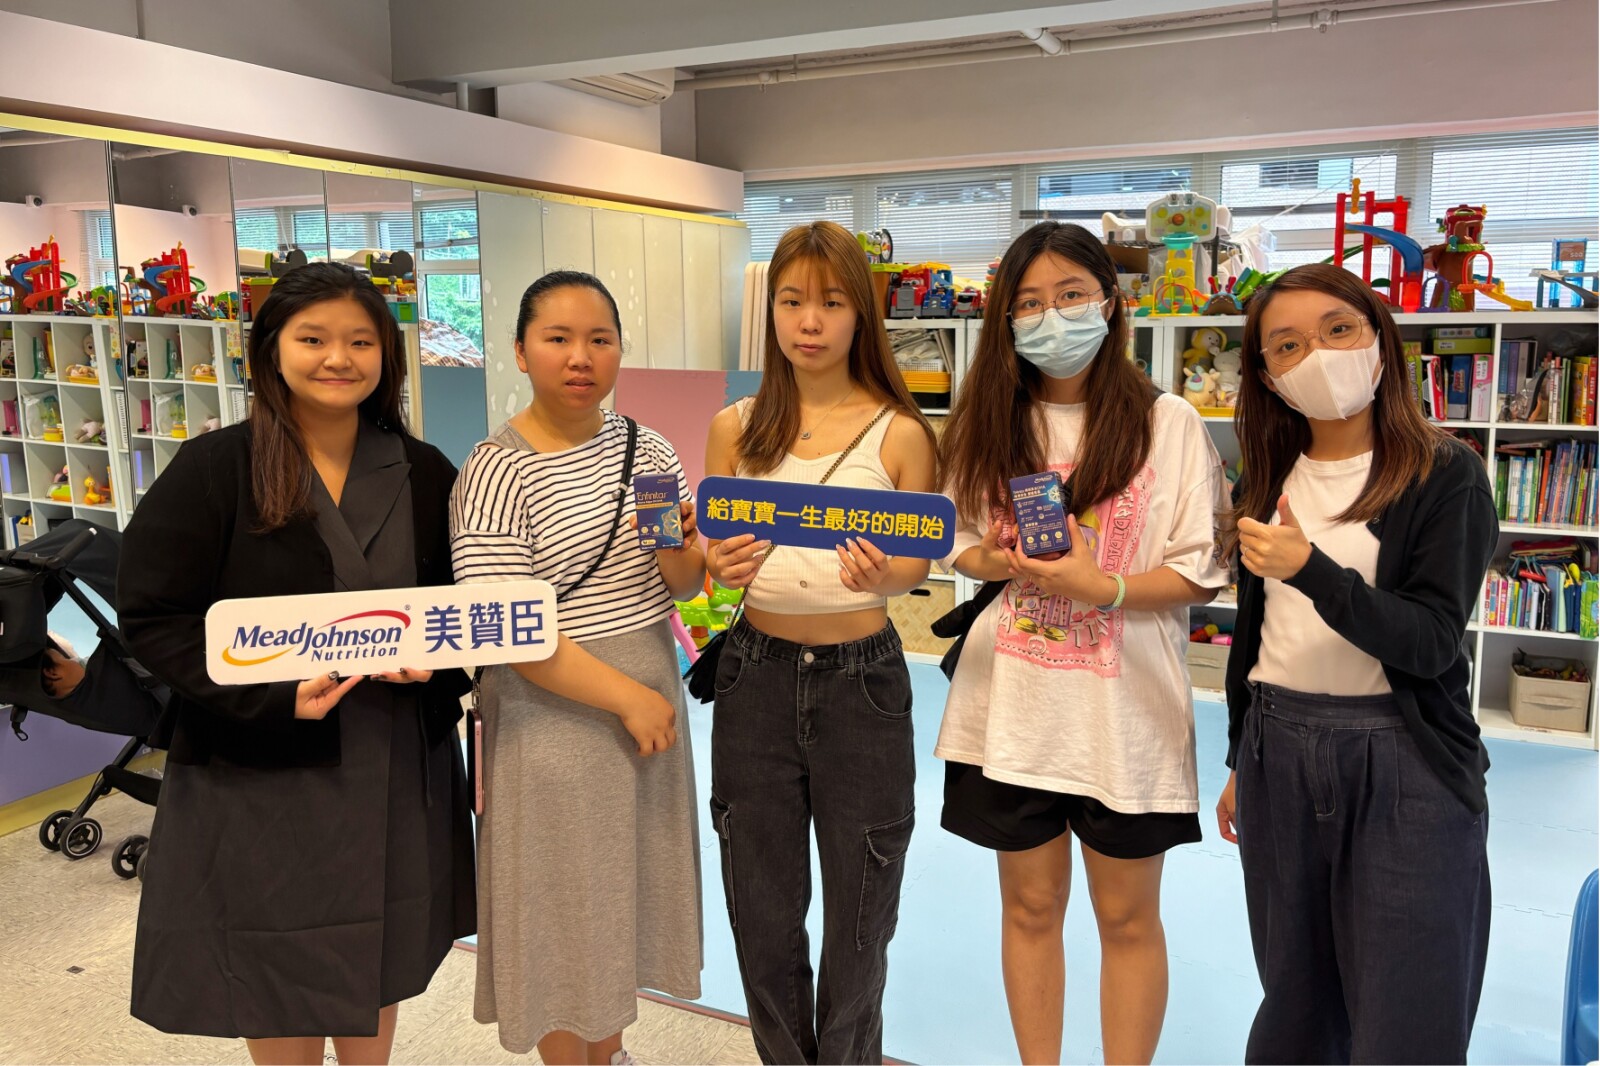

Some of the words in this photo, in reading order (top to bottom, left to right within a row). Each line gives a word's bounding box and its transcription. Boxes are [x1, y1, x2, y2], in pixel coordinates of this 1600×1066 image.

[707, 496, 945, 540] 給寶寶一生最好的開始
[424, 599, 546, 654] 美贊臣
[311, 644, 398, 662] Nutrition
